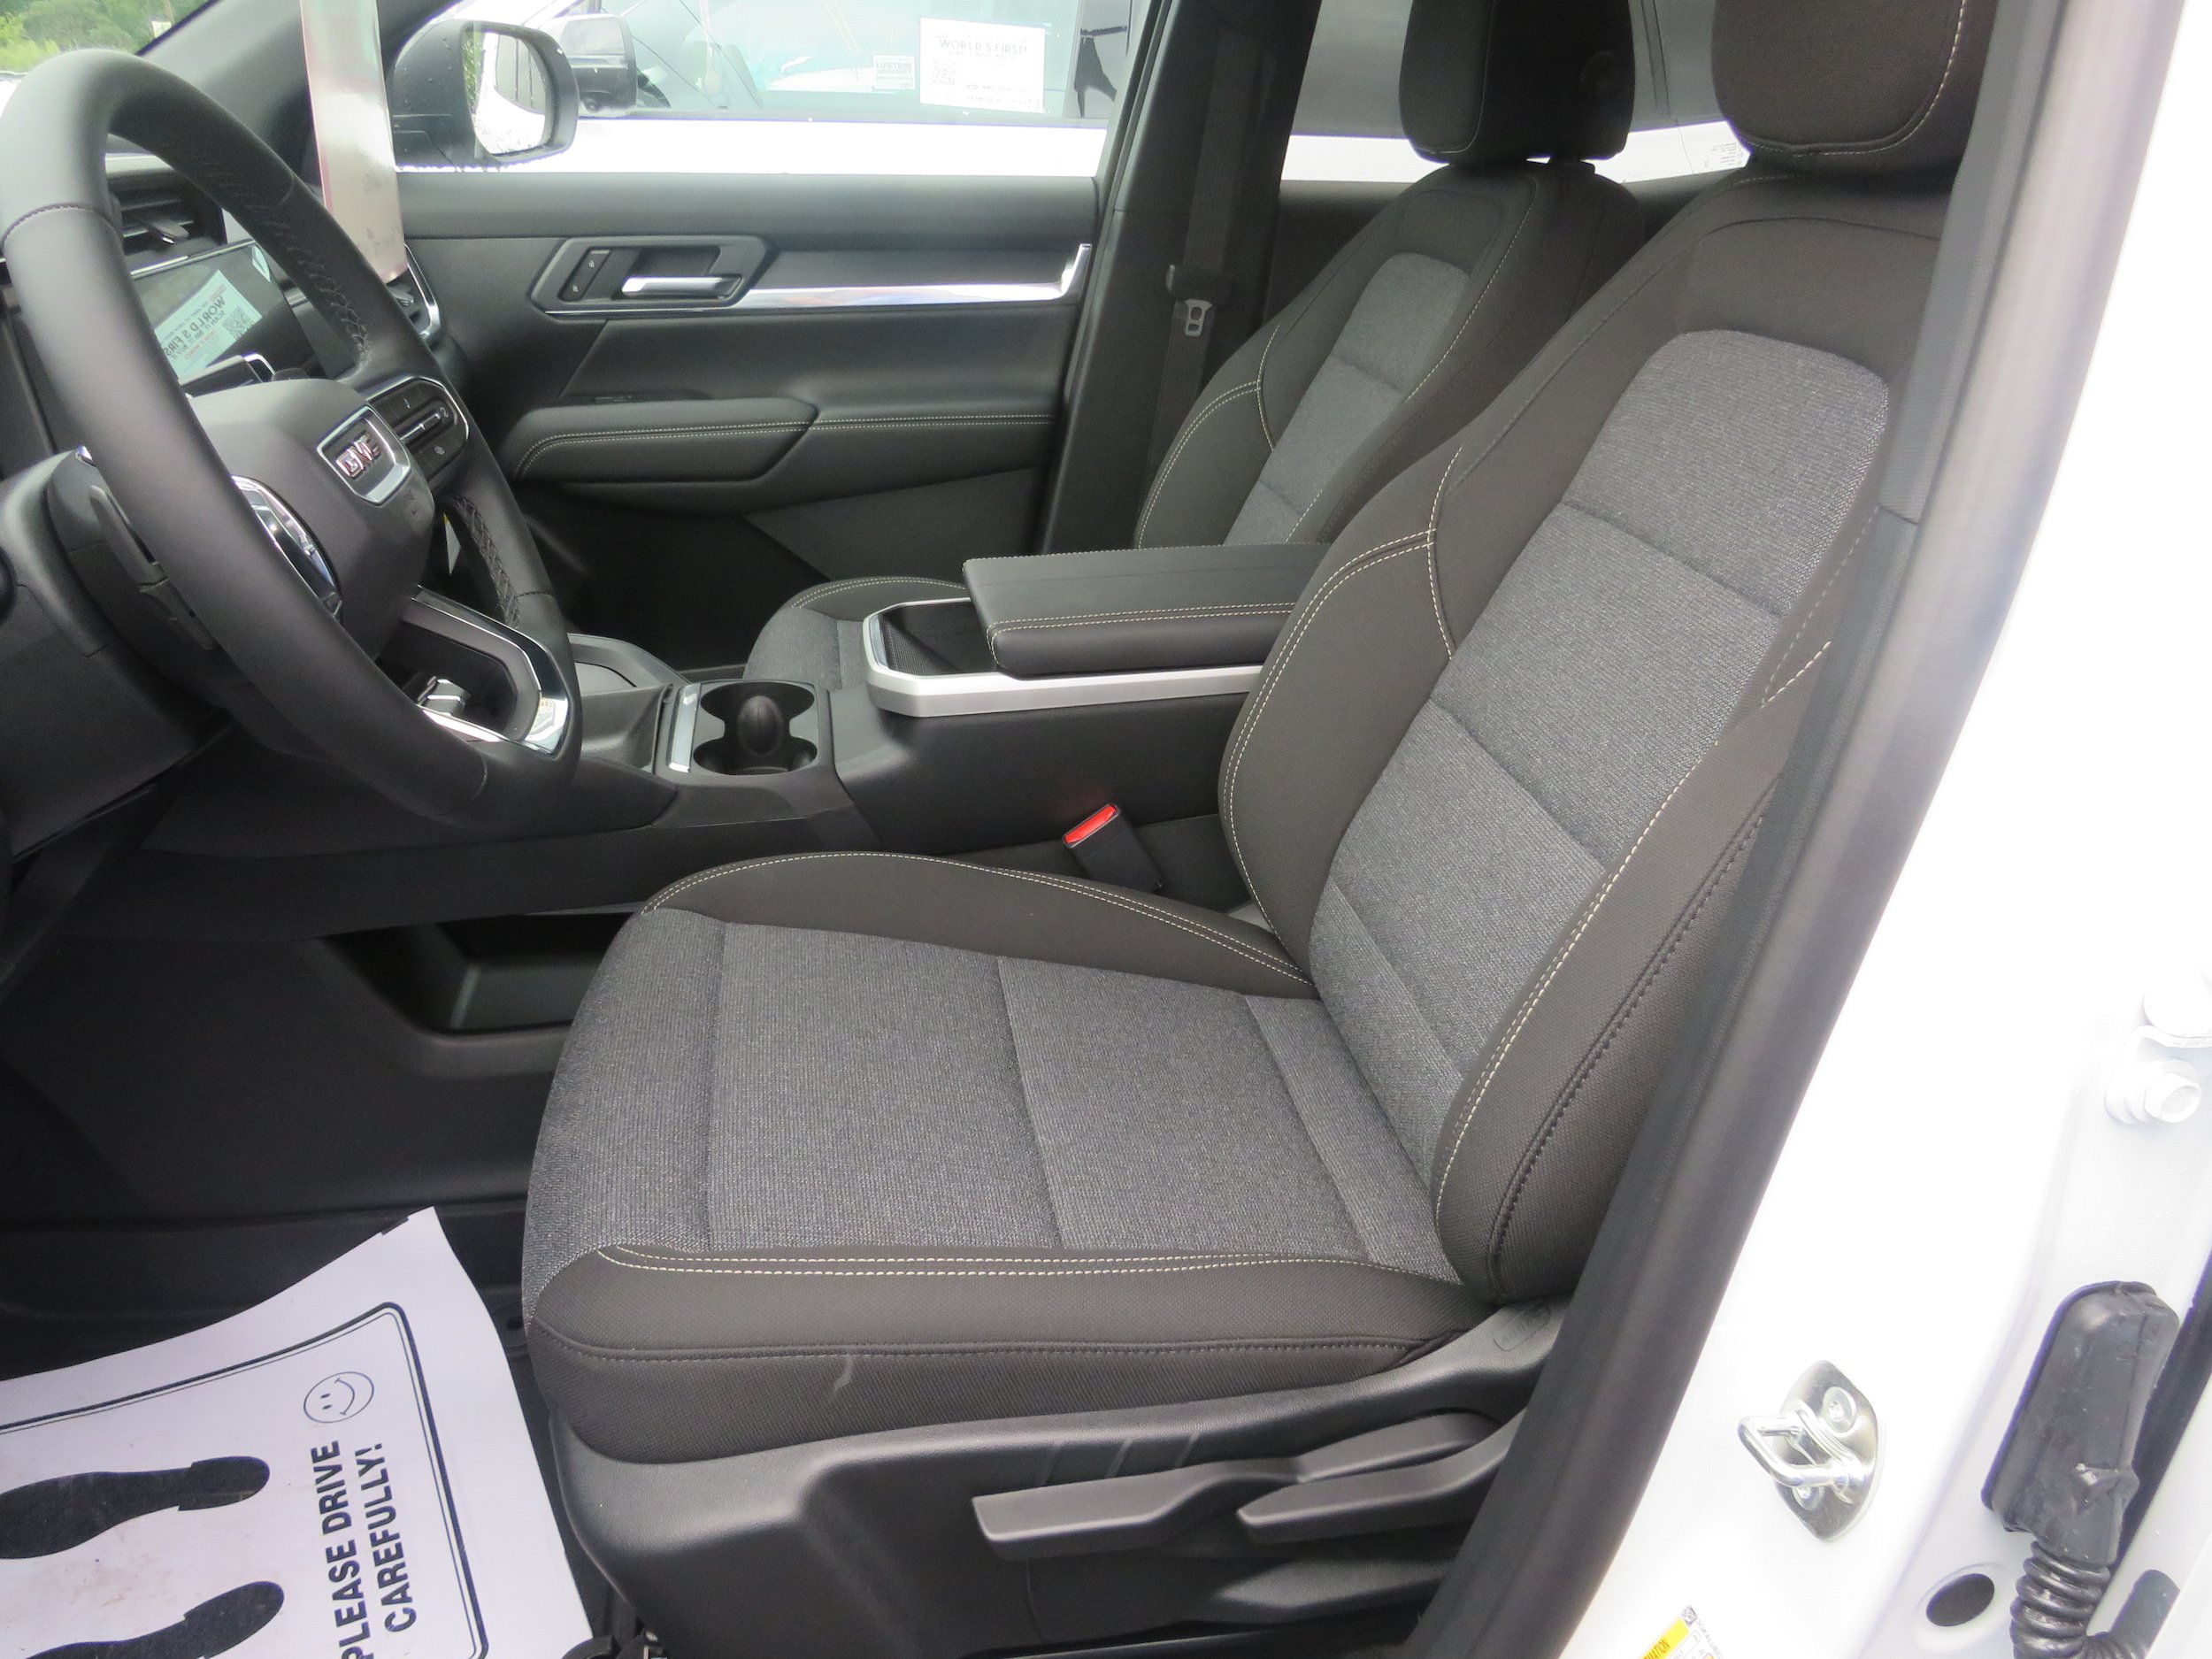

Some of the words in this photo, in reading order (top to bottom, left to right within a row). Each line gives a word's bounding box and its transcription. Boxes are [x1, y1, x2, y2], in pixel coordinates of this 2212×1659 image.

[335, 433, 380, 477] GMC
[311, 1440, 352, 1535] DRIVE
[355, 1443, 417, 1632] CAREFULLY!
[325, 1540, 374, 1659] PLEASE
